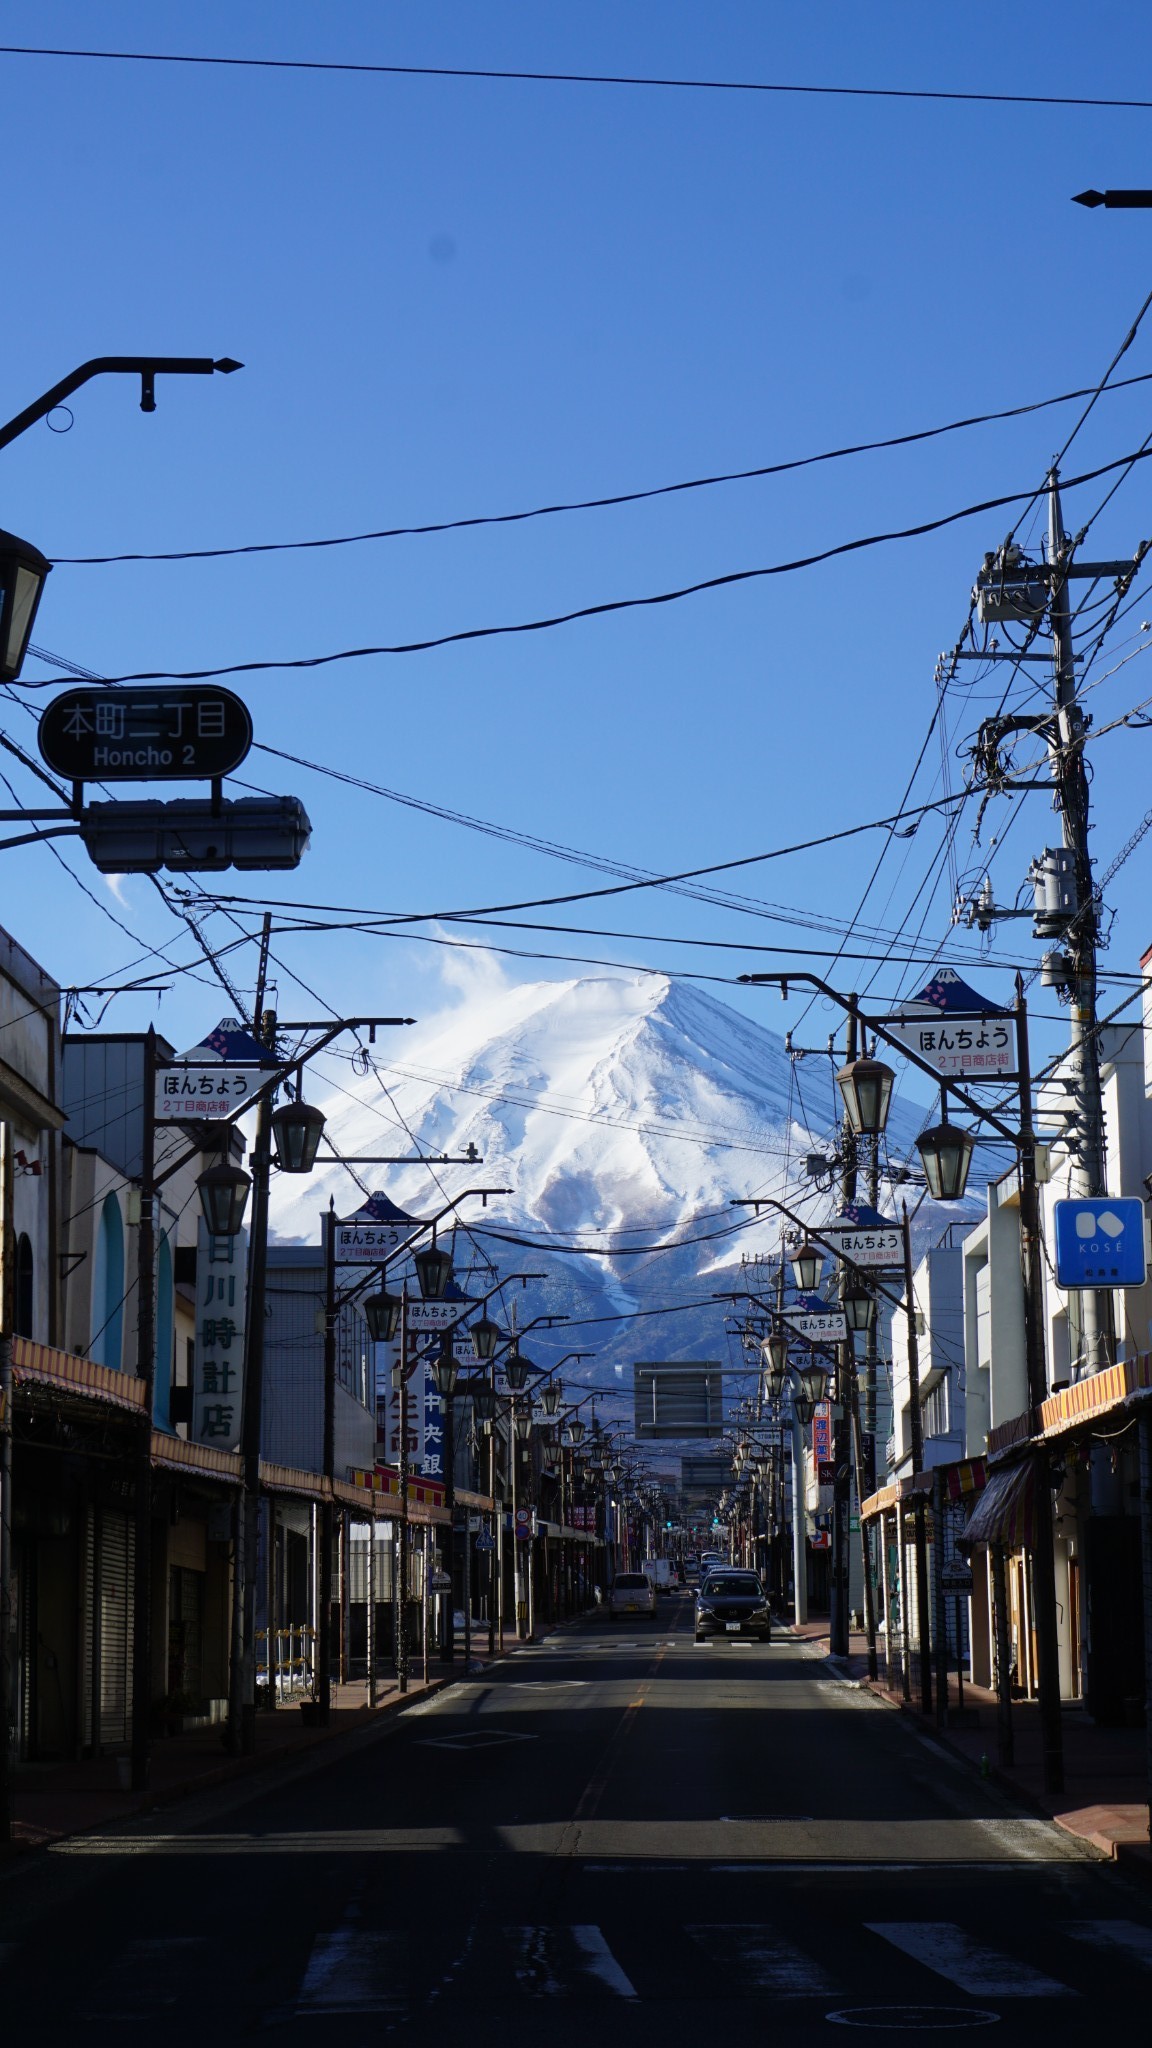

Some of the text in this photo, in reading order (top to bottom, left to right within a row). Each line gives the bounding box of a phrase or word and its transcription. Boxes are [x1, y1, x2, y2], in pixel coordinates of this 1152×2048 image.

[62, 702, 225, 741] 本町二丁目
[93, 745, 195, 766] Honcho 2
[919, 1027, 1009, 1051] ほんちょう
[938, 1053, 1009, 1068] 2丁目商店街
[164, 1075, 248, 1095] ほんちょう
[163, 1100, 230, 1113] 2丁目商店街
[340, 1231, 399, 1245] ほんちょう
[841, 1234, 898, 1250] ほんちょう
[1079, 1240, 1123, 1253] KOSÉ
[411, 1307, 458, 1318] ほんちょう
[800, 1317, 843, 1330] ほんちょう
